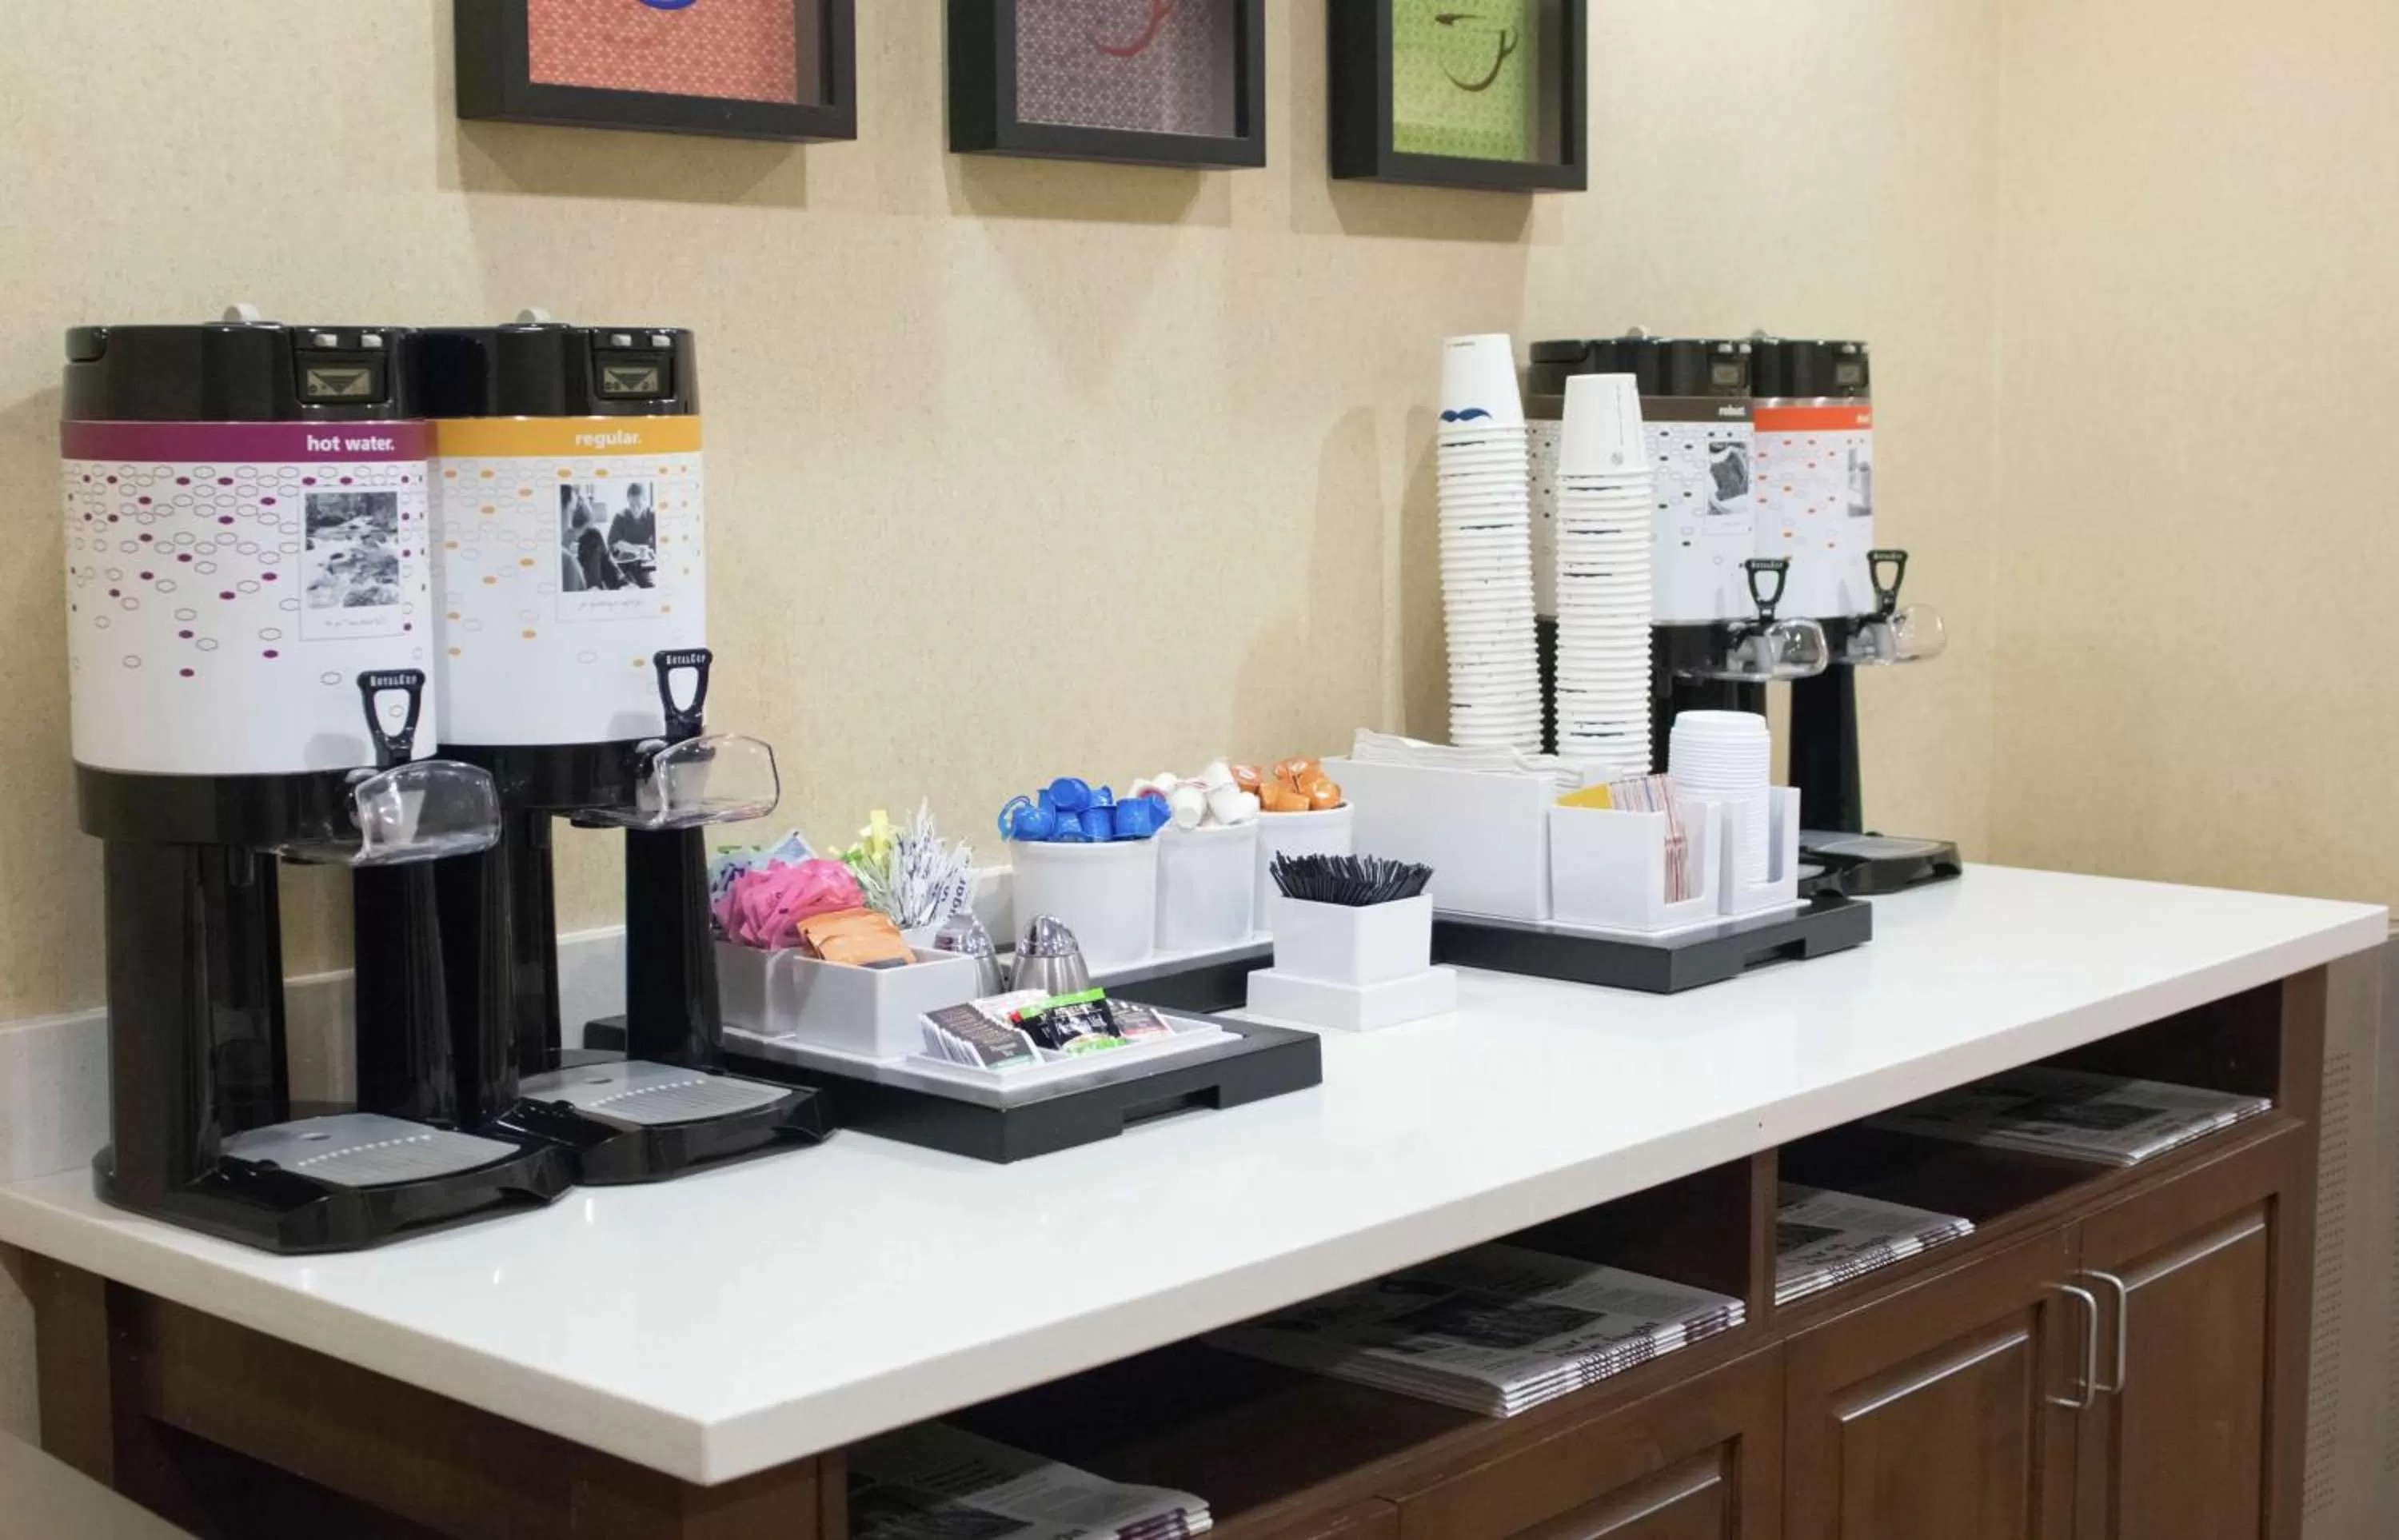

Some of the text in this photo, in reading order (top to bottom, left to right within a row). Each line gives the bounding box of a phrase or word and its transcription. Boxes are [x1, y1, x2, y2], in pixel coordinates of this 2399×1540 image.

[306, 434, 397, 451] hot water.
[575, 429, 642, 449] regular.
